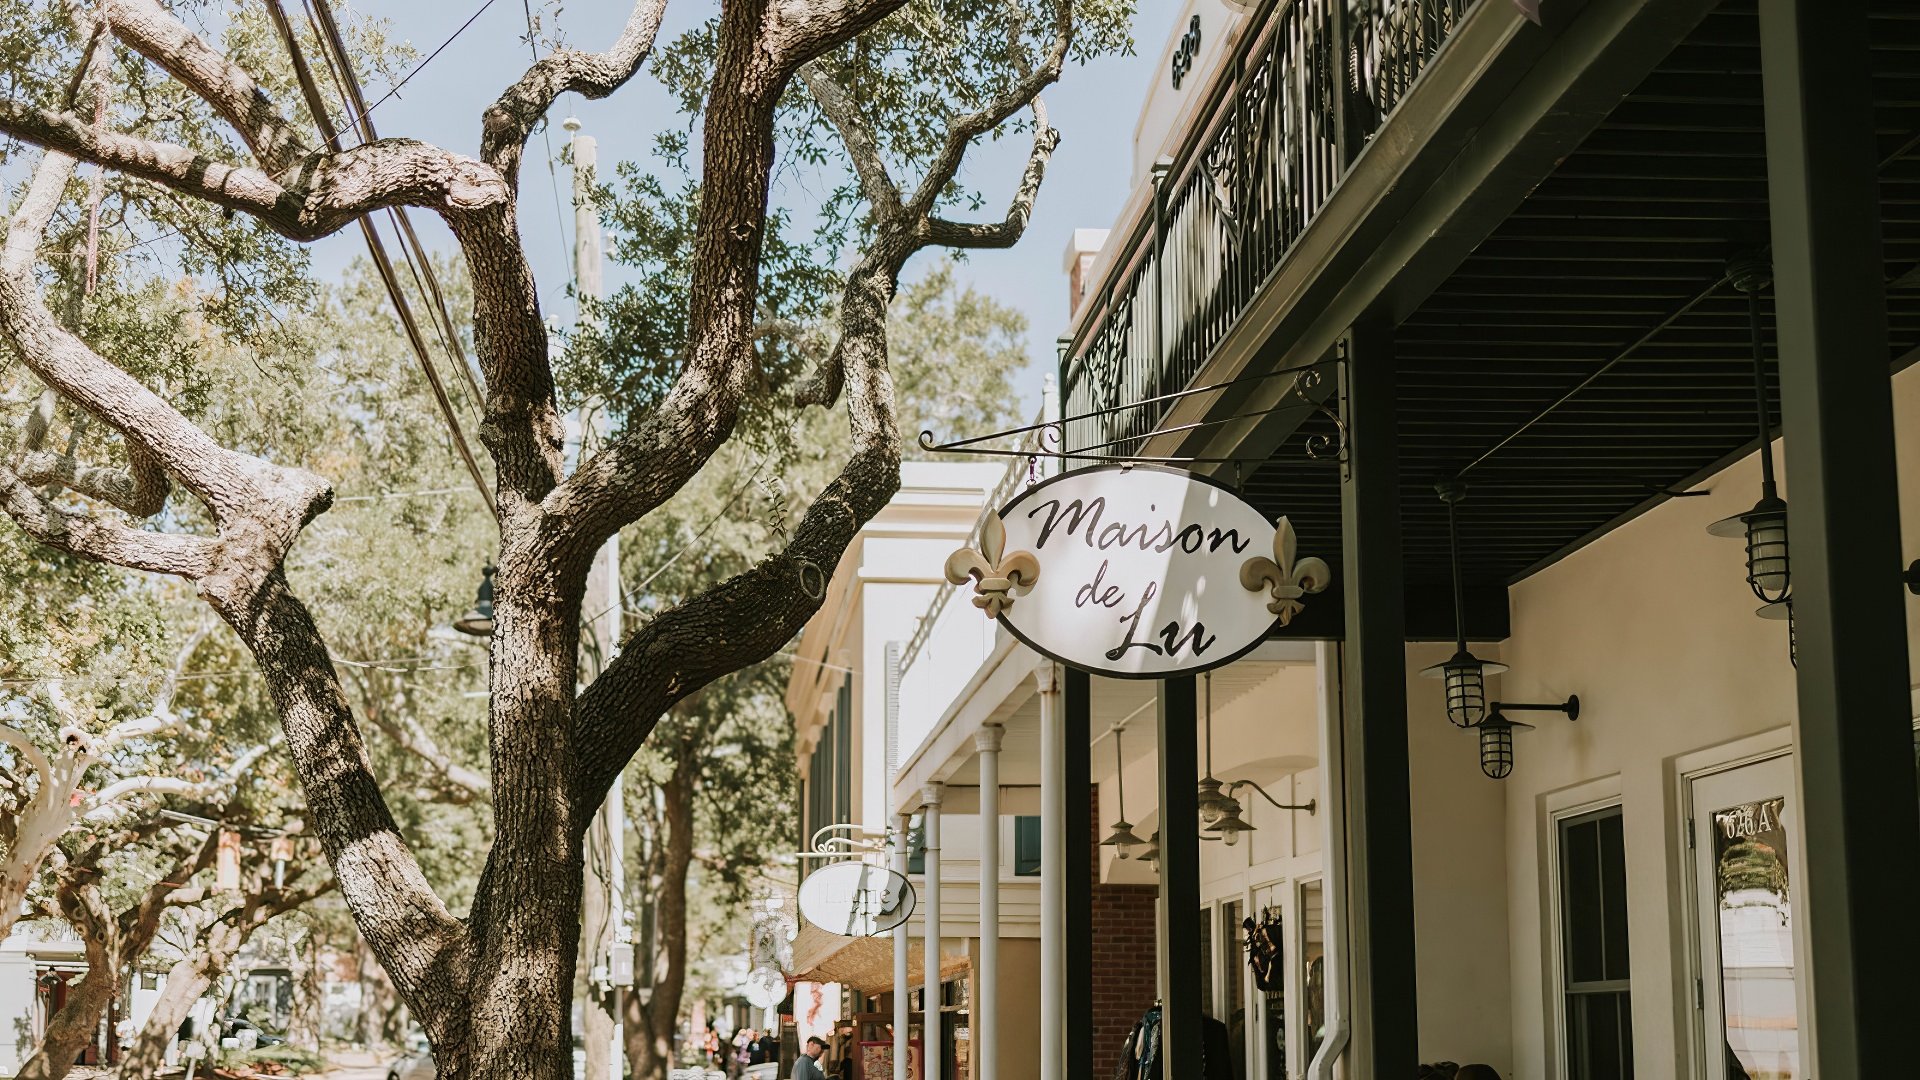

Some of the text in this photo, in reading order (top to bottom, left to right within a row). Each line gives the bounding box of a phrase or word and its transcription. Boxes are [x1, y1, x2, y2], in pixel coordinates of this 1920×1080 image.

[1028, 496, 1249, 553] Maison
[1075, 559, 1125, 608] de
[1105, 581, 1216, 661] Lu
